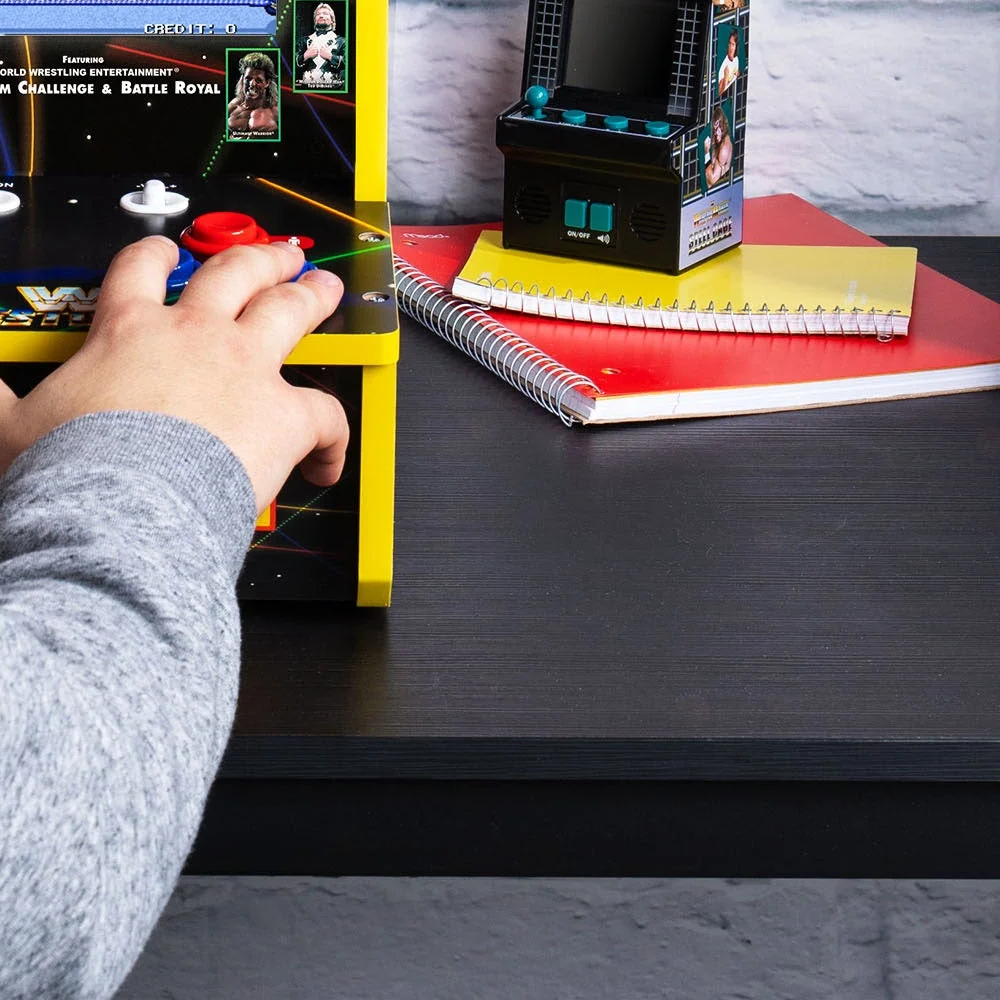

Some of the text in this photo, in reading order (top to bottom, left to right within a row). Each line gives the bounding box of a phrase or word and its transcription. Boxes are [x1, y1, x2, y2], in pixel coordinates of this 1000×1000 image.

[144, 23, 237, 34] CREDIT: 0
[29, 68, 88, 77] WRESTLING
[102, 81, 112, 95] &
[567, 230, 591, 240] ON/OFF
